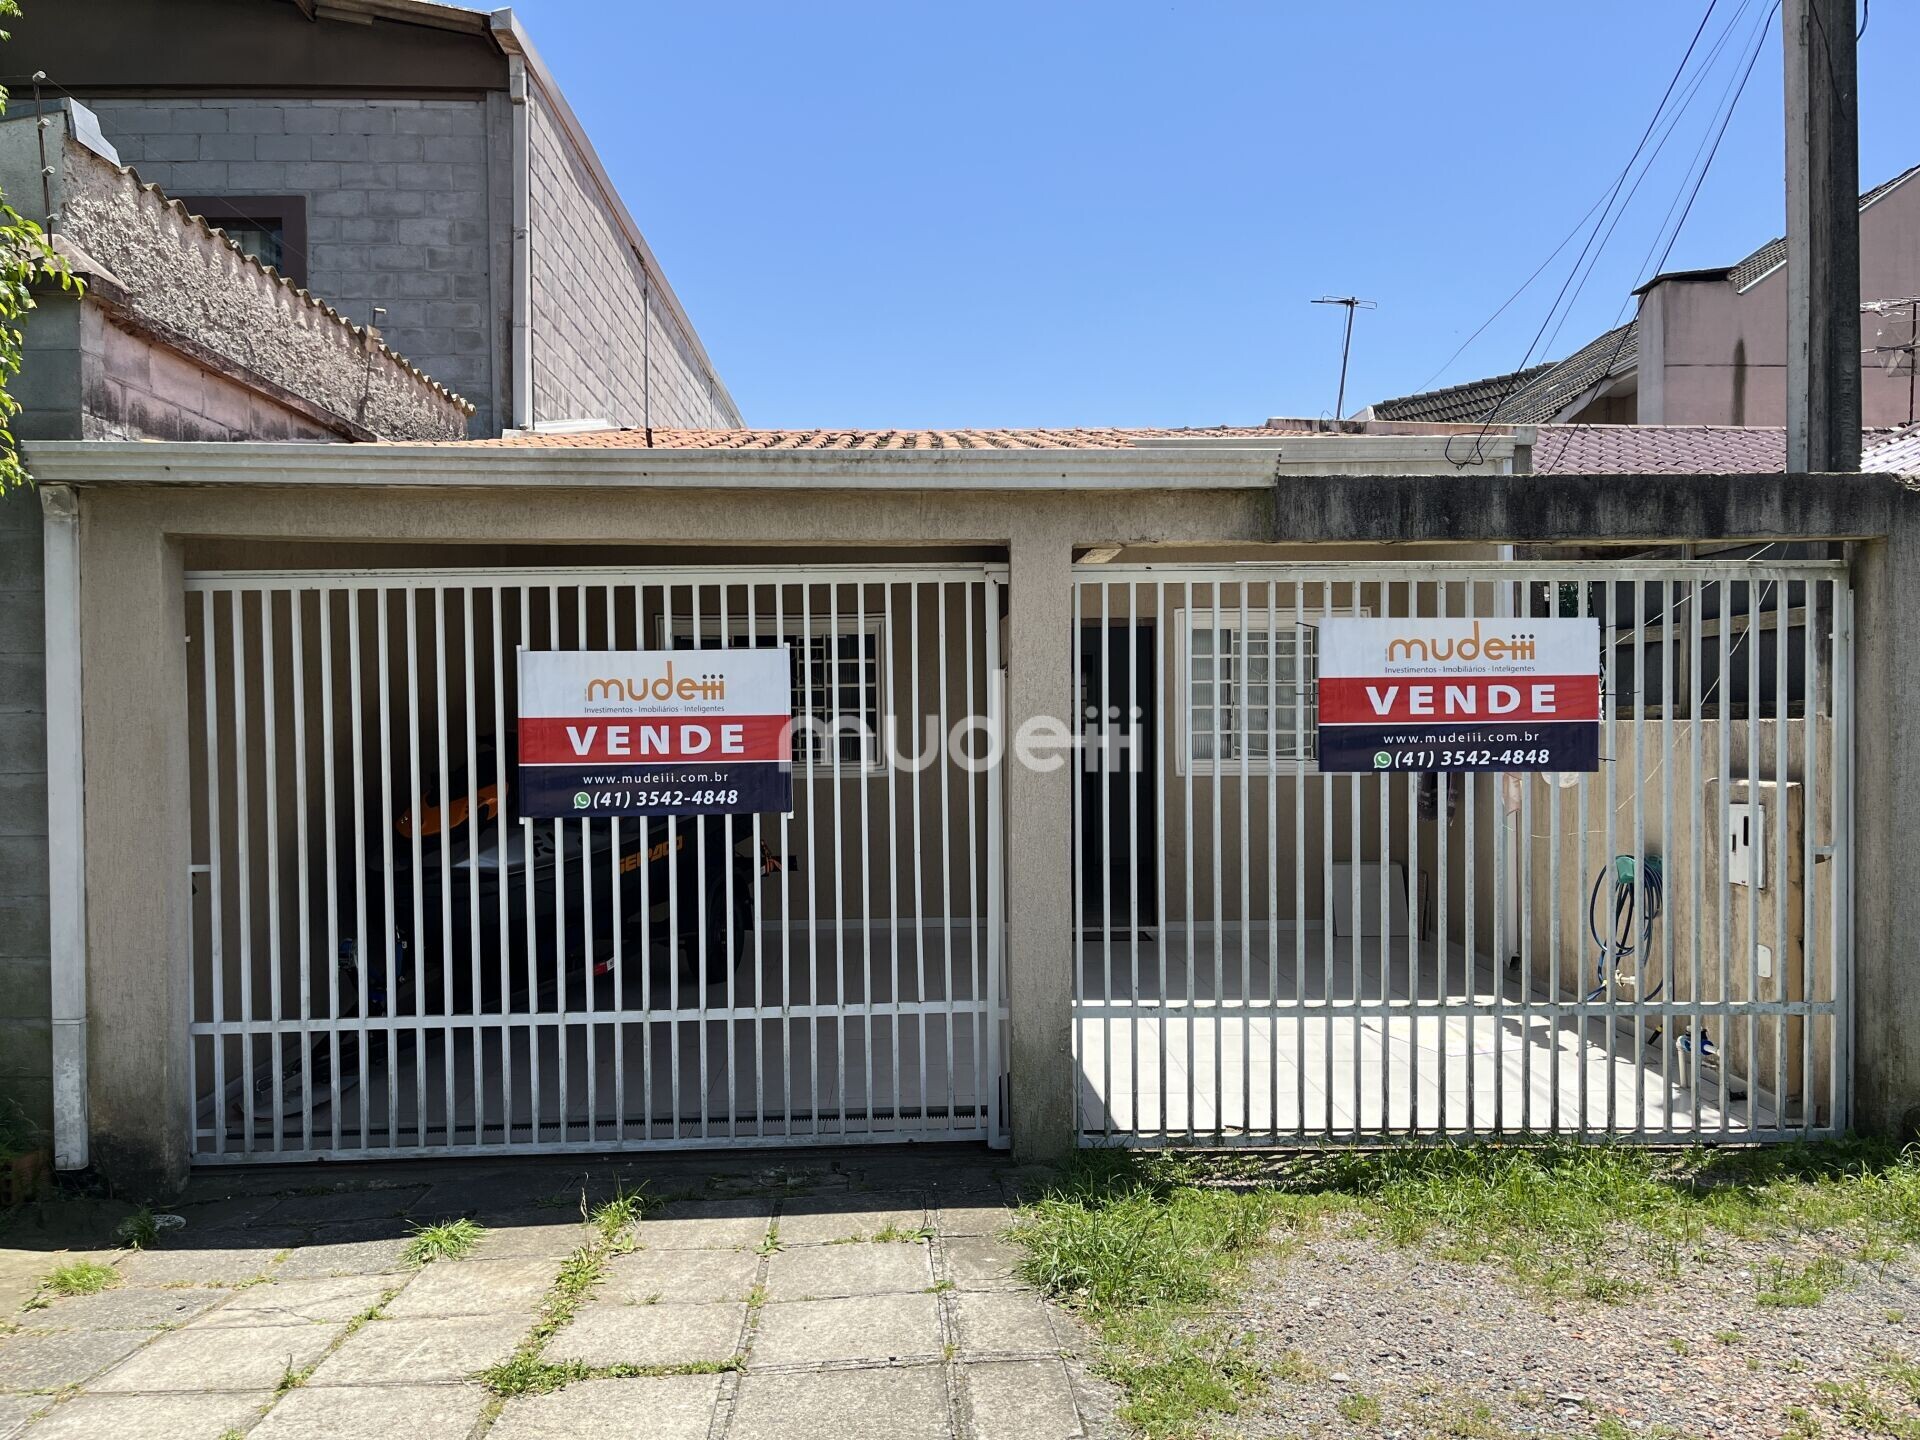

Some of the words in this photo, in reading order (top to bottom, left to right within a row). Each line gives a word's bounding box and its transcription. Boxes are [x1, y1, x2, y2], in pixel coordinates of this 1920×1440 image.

[1388, 620, 1536, 662] mudeiii
[1384, 666, 1437, 674] Investimentos
[1443, 665, 1486, 673] Imobiliários
[1492, 665, 1536, 674] Inteligentes
[587, 660, 725, 702] mudeiii
[584, 706, 633, 714] Investimentos
[639, 705, 679, 713] Imobiliários
[685, 705, 725, 713] Inteligentes
[1365, 684, 1557, 716] VENDE
[565, 725, 744, 755] VENDE
[1383, 731, 1540, 744] www.mudeiii.com.br
[1395, 749, 1435, 769] (41)
[1440, 749, 1550, 766] 3542-4848
[583, 772, 728, 785] www.mudeiii.com.br
[593, 791, 631, 809] (41)
[636, 789, 738, 807] 3542-4848
